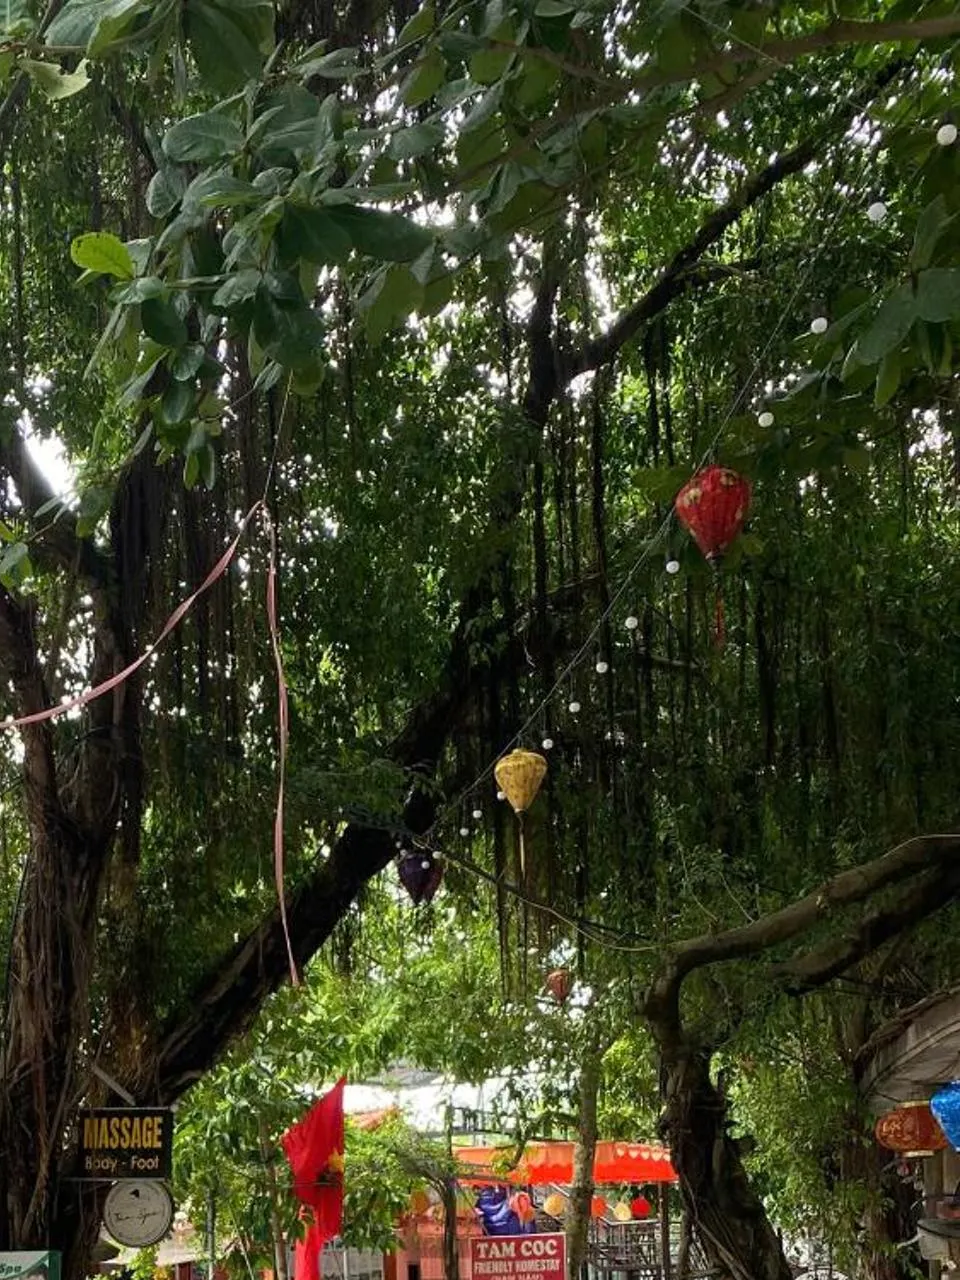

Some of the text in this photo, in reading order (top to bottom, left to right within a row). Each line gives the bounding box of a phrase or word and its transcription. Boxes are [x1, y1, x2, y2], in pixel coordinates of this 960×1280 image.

[84, 1116, 163, 1149] MASSAGE
[130, 1155, 160, 1170] Foot
[477, 1239, 557, 1258] TAM COC
[474, 1258, 560, 1275] FRIENDLY HOMESTAY
